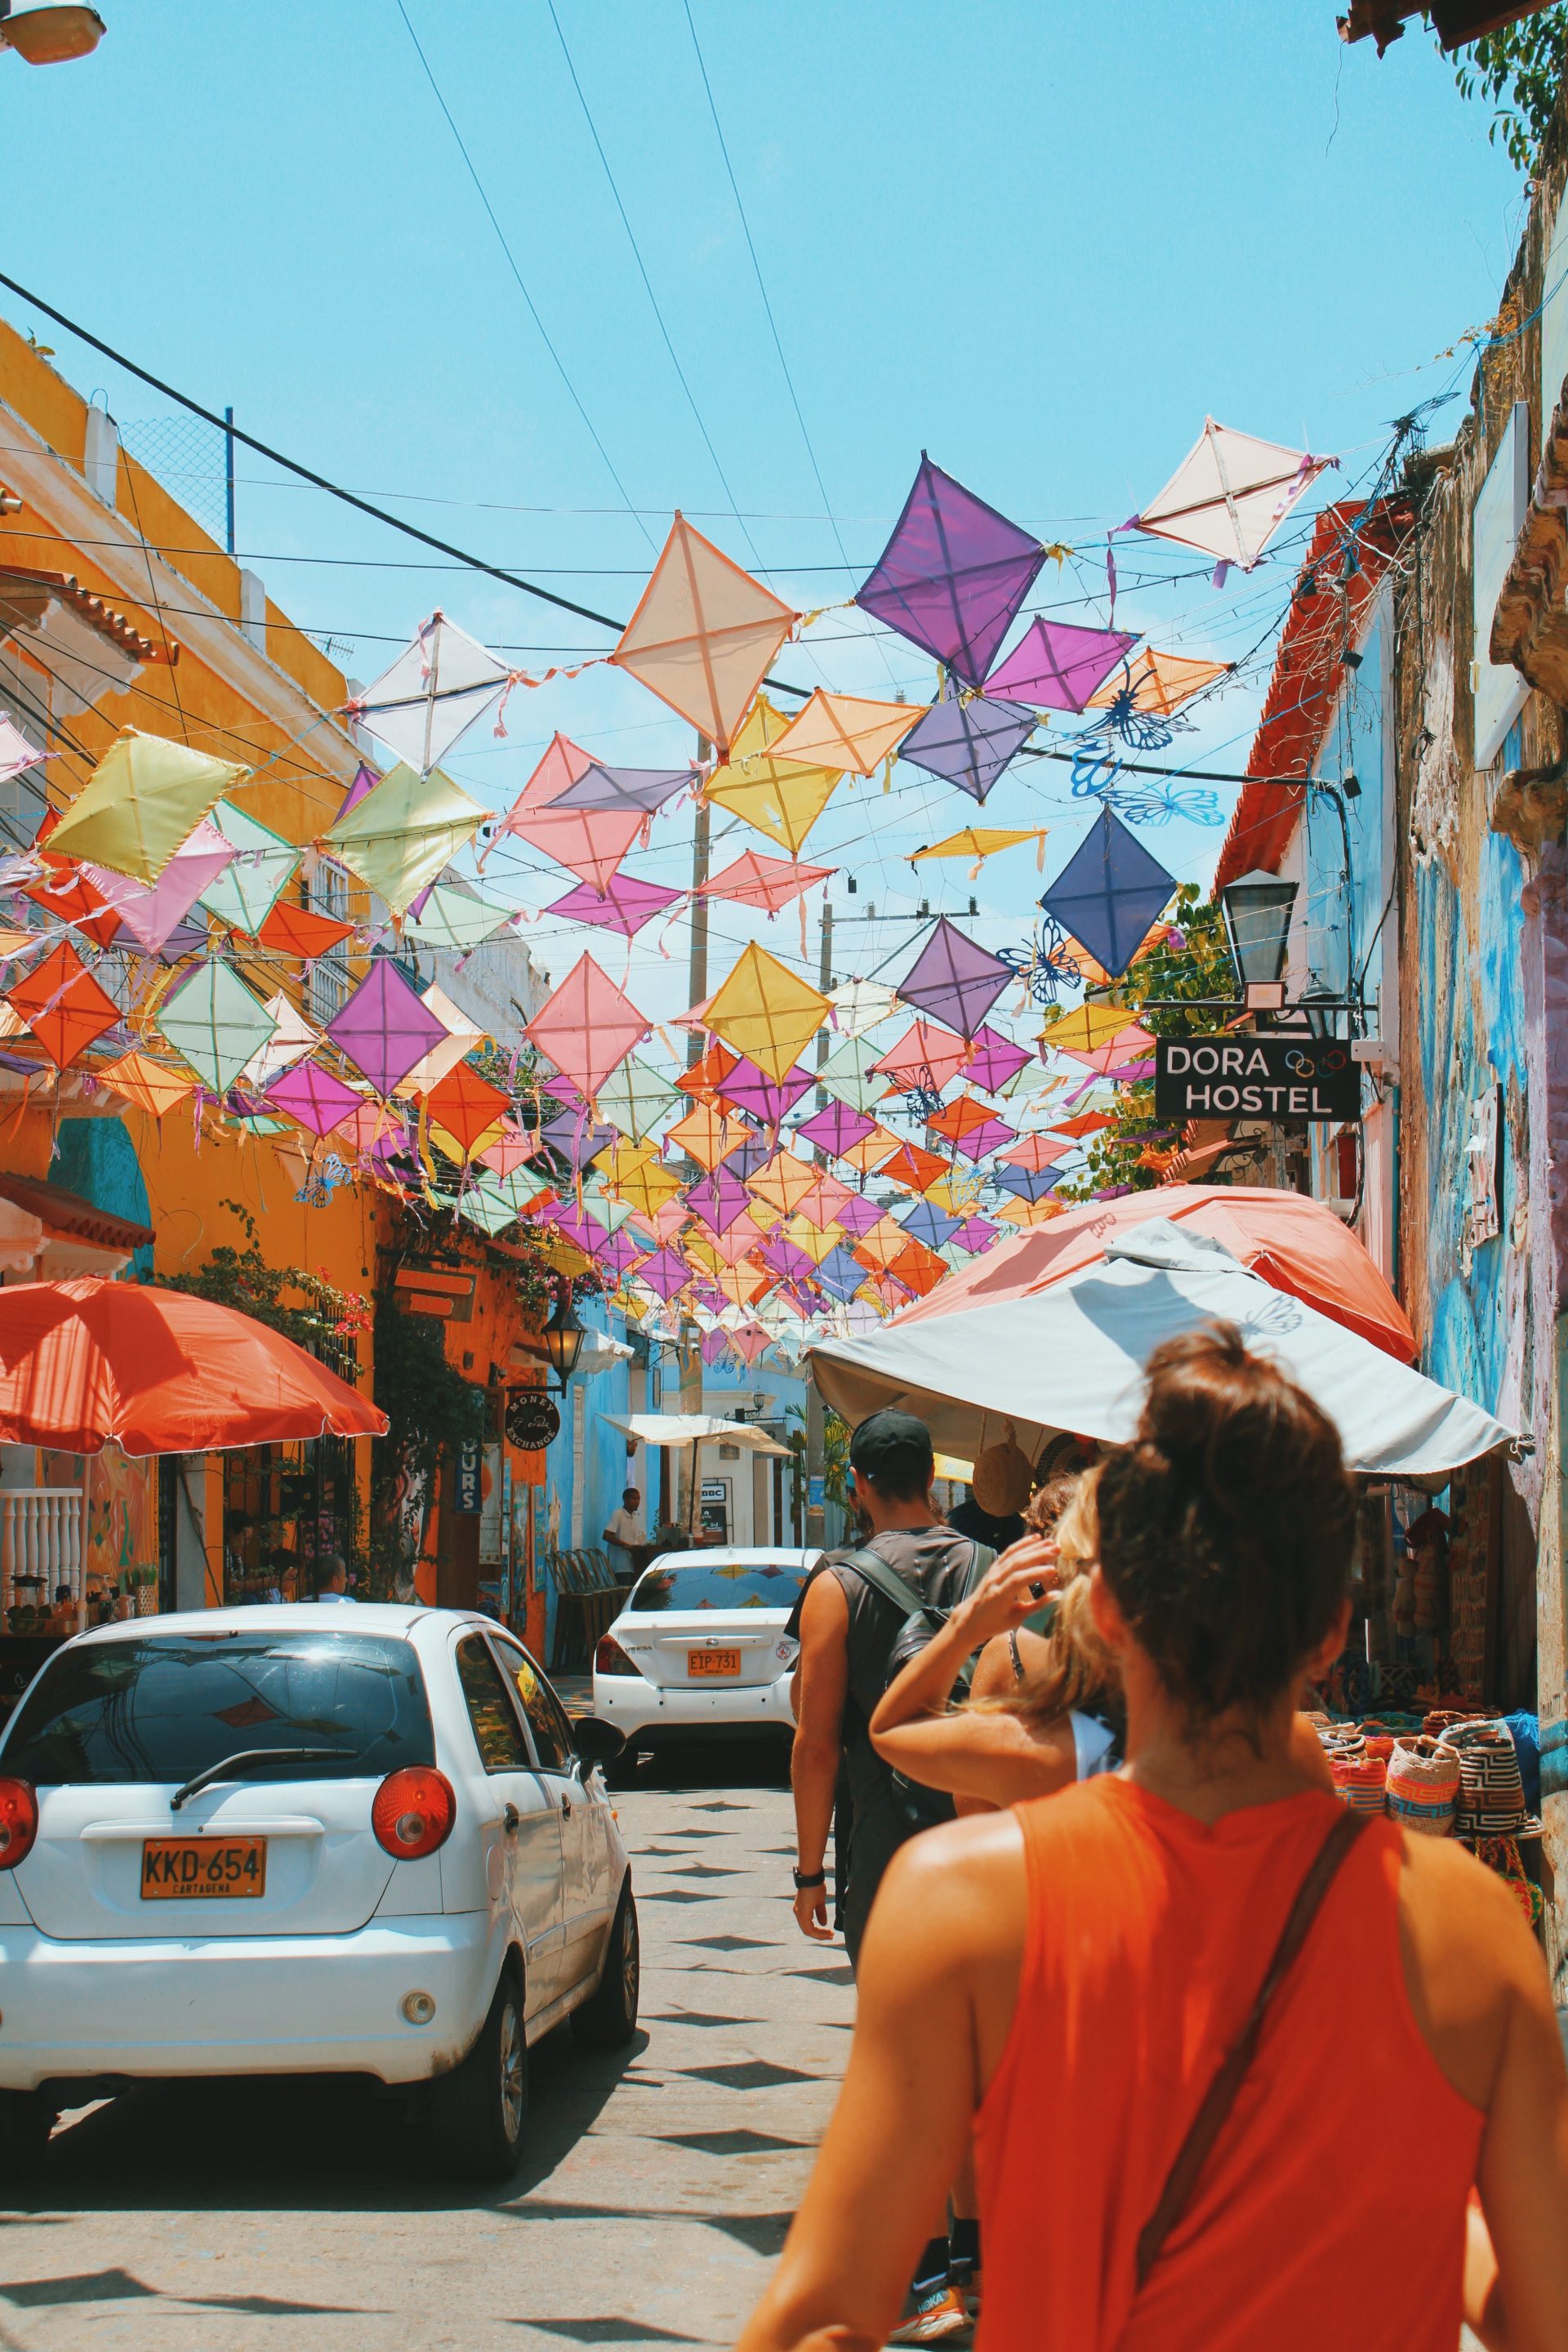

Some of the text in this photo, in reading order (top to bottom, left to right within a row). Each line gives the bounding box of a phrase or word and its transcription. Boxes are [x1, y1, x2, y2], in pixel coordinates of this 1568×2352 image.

[1166, 1045, 1270, 1077] DORA
[1185, 1084, 1333, 1114] HOSTEL
[509, 1396, 555, 1412] MONEY
[506, 1427, 556, 1449] EXCHANGE
[172, 1883, 230, 1895] CARTAGENA
[917, 2291, 945, 2314] HOKA
